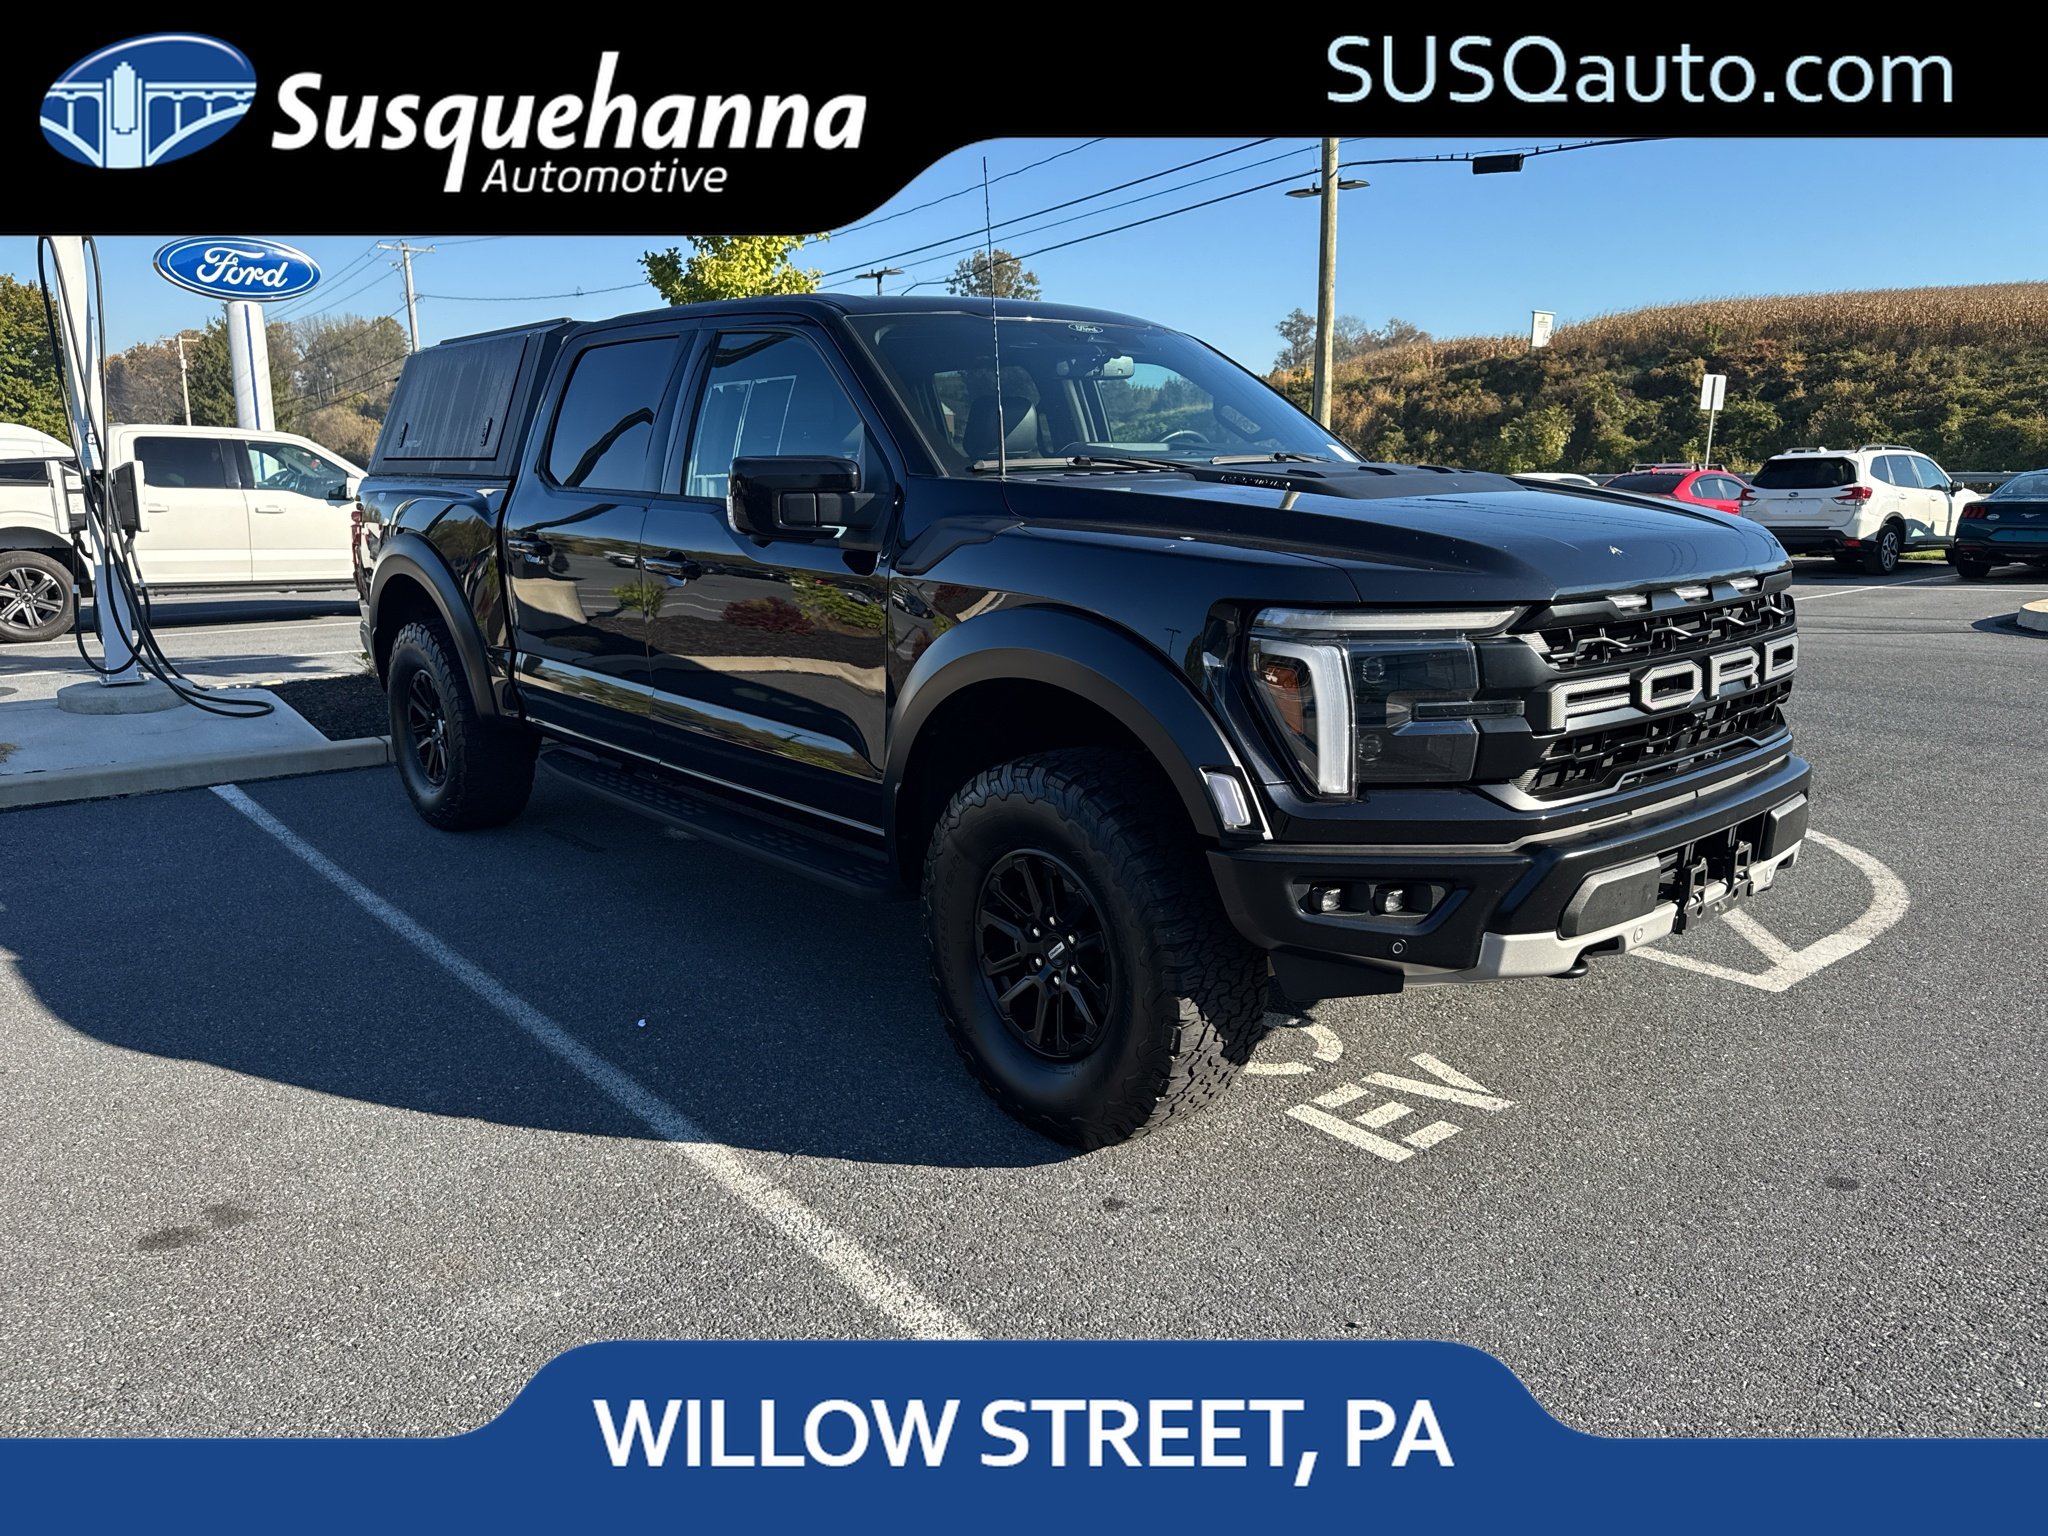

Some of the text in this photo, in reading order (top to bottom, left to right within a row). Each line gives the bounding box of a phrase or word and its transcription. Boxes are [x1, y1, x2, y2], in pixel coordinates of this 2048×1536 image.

[196, 247, 289, 288] Ford
[1550, 634, 1799, 730] FORD
[1284, 1052, 1514, 1162] EV
